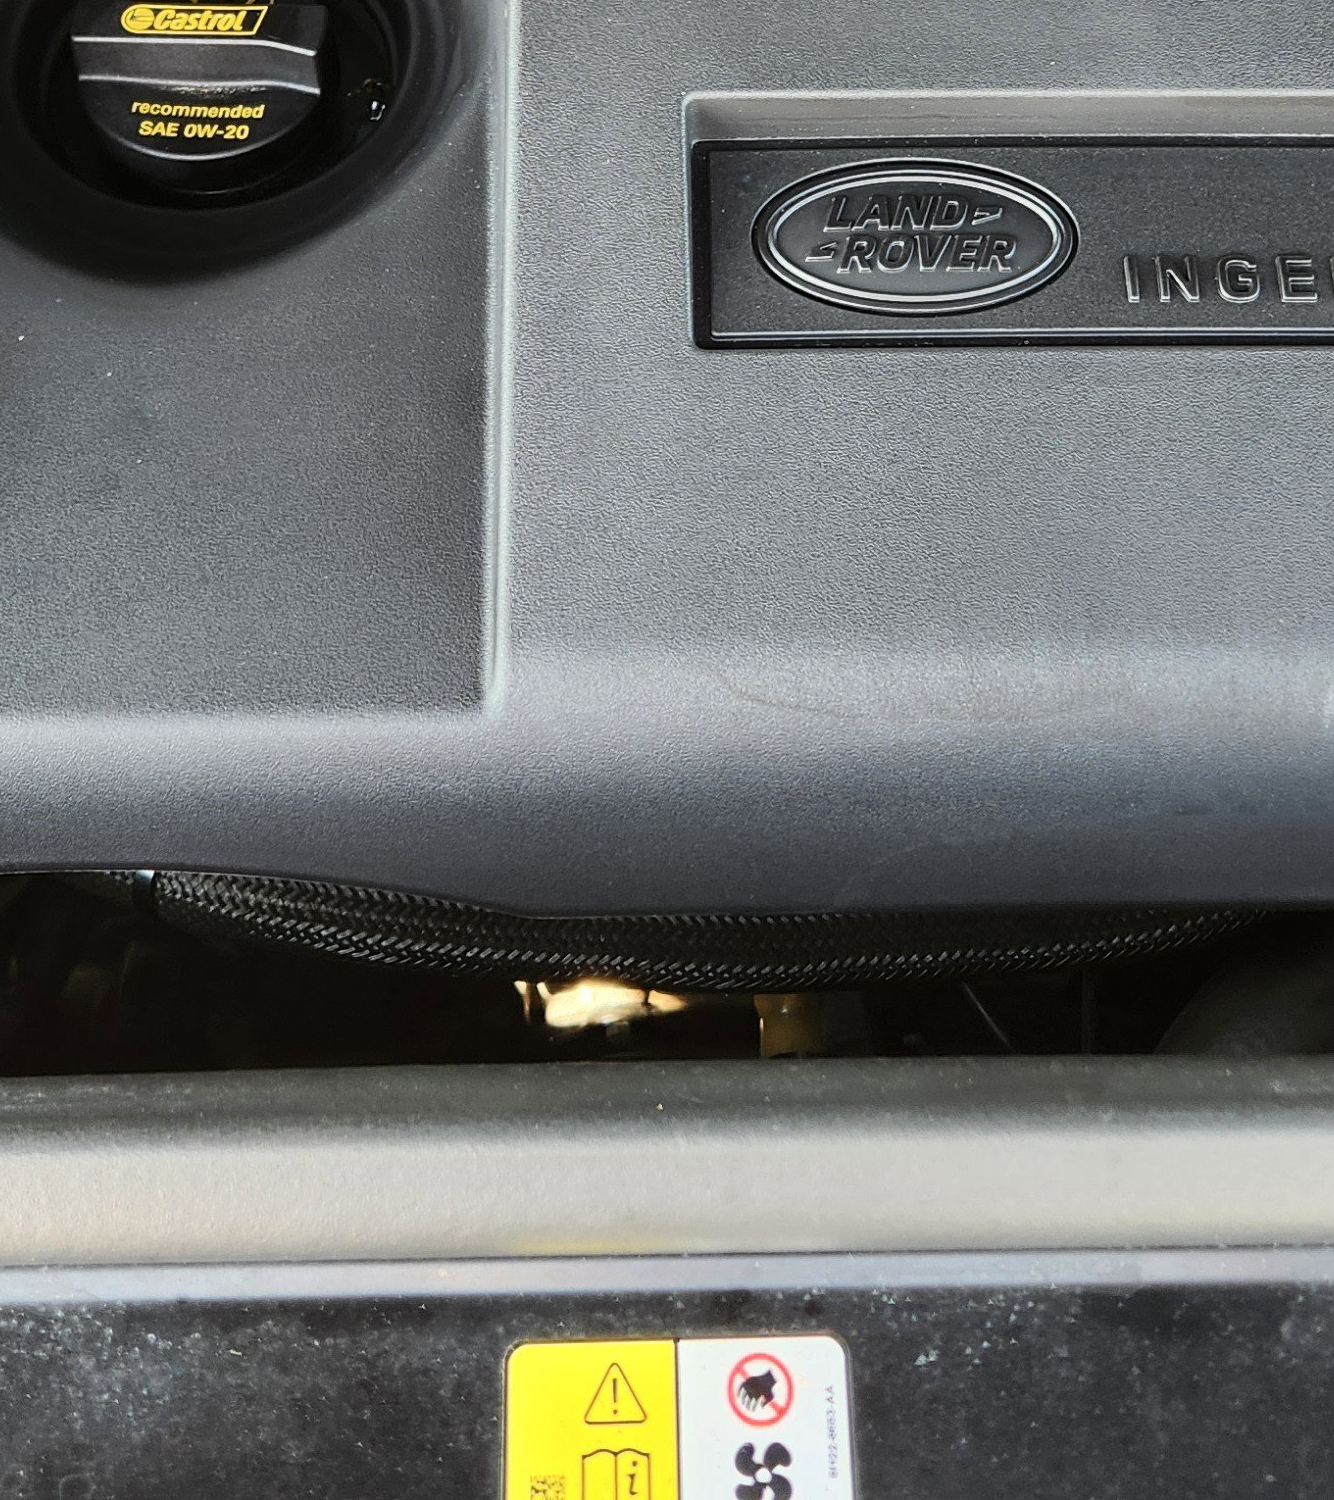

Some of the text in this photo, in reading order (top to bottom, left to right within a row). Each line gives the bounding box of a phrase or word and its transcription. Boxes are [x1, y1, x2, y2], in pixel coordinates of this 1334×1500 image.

[153, 9, 247, 31] Castrol
[131, 101, 266, 119] recommended
[138, 120, 250, 140] SAE 0W-20
[823, 194, 969, 233] LAND
[836, 233, 1017, 274] ROVER
